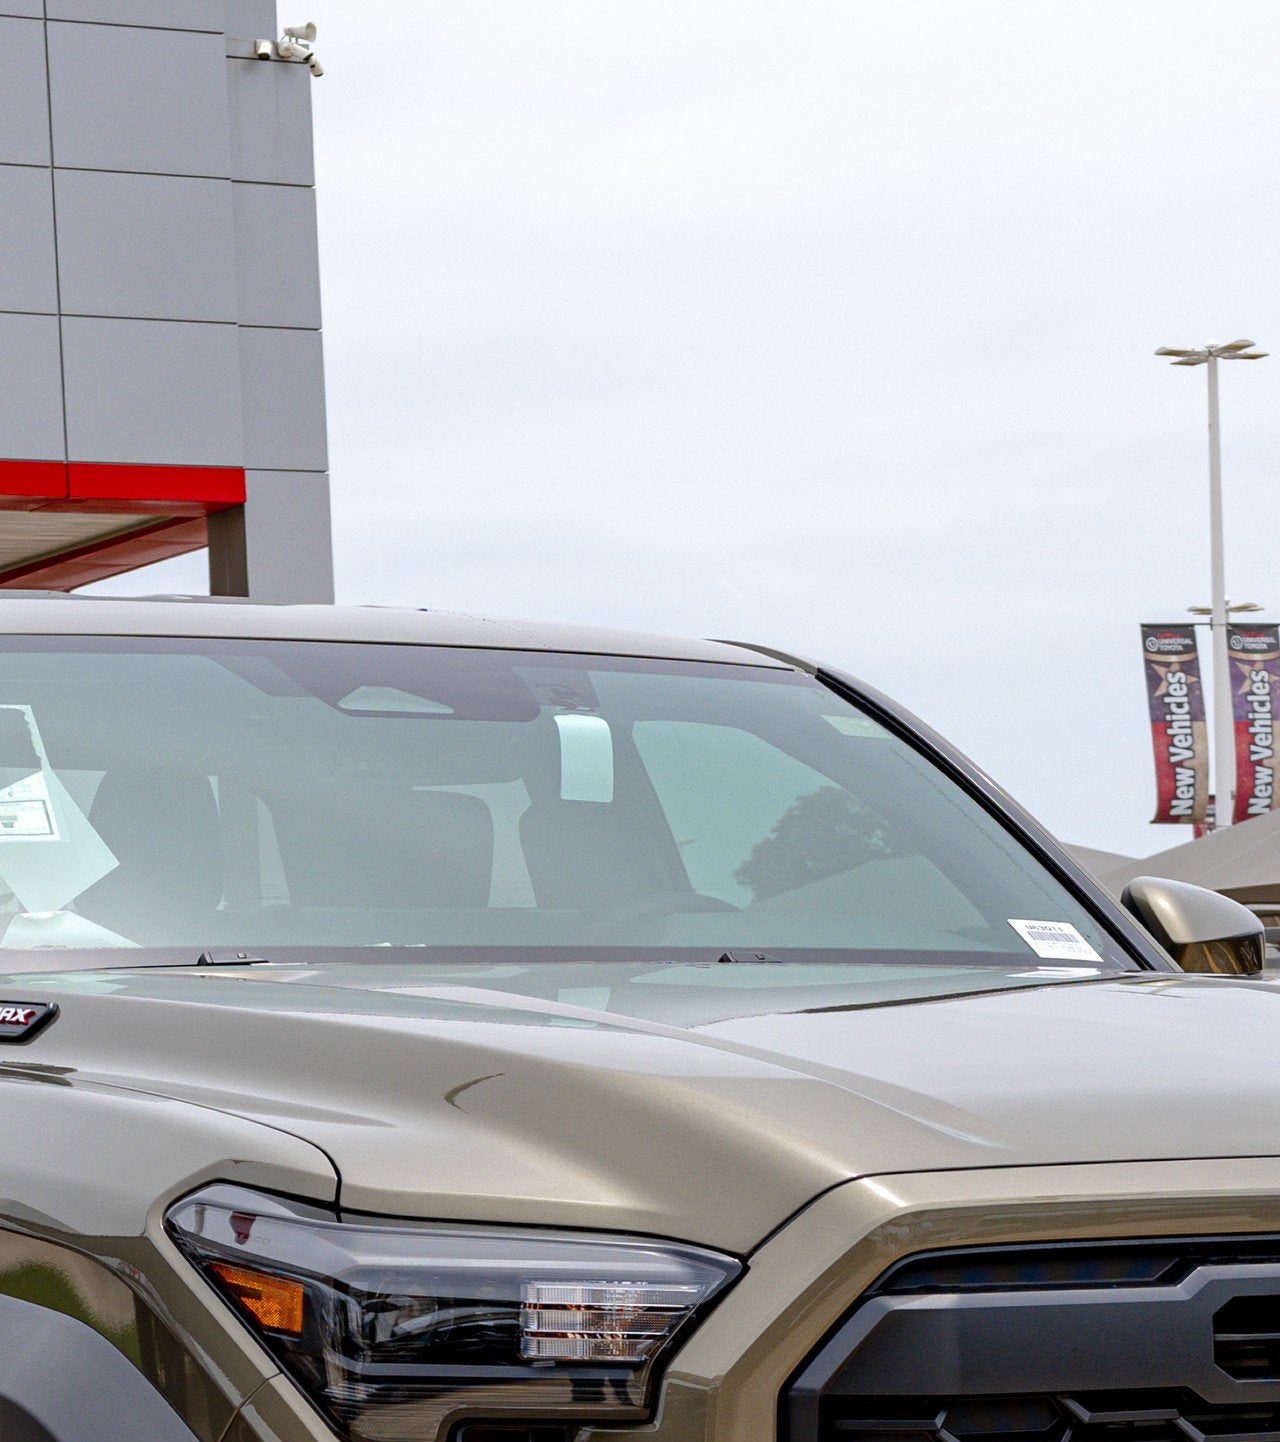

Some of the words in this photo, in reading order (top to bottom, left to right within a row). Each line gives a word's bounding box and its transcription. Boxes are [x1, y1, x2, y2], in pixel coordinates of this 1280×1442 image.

[1164, 671, 1195, 763] Vehicles
[1247, 669, 1271, 761] Vehicles
[1170, 767, 1196, 816] New
[1248, 766, 1273, 814] New
